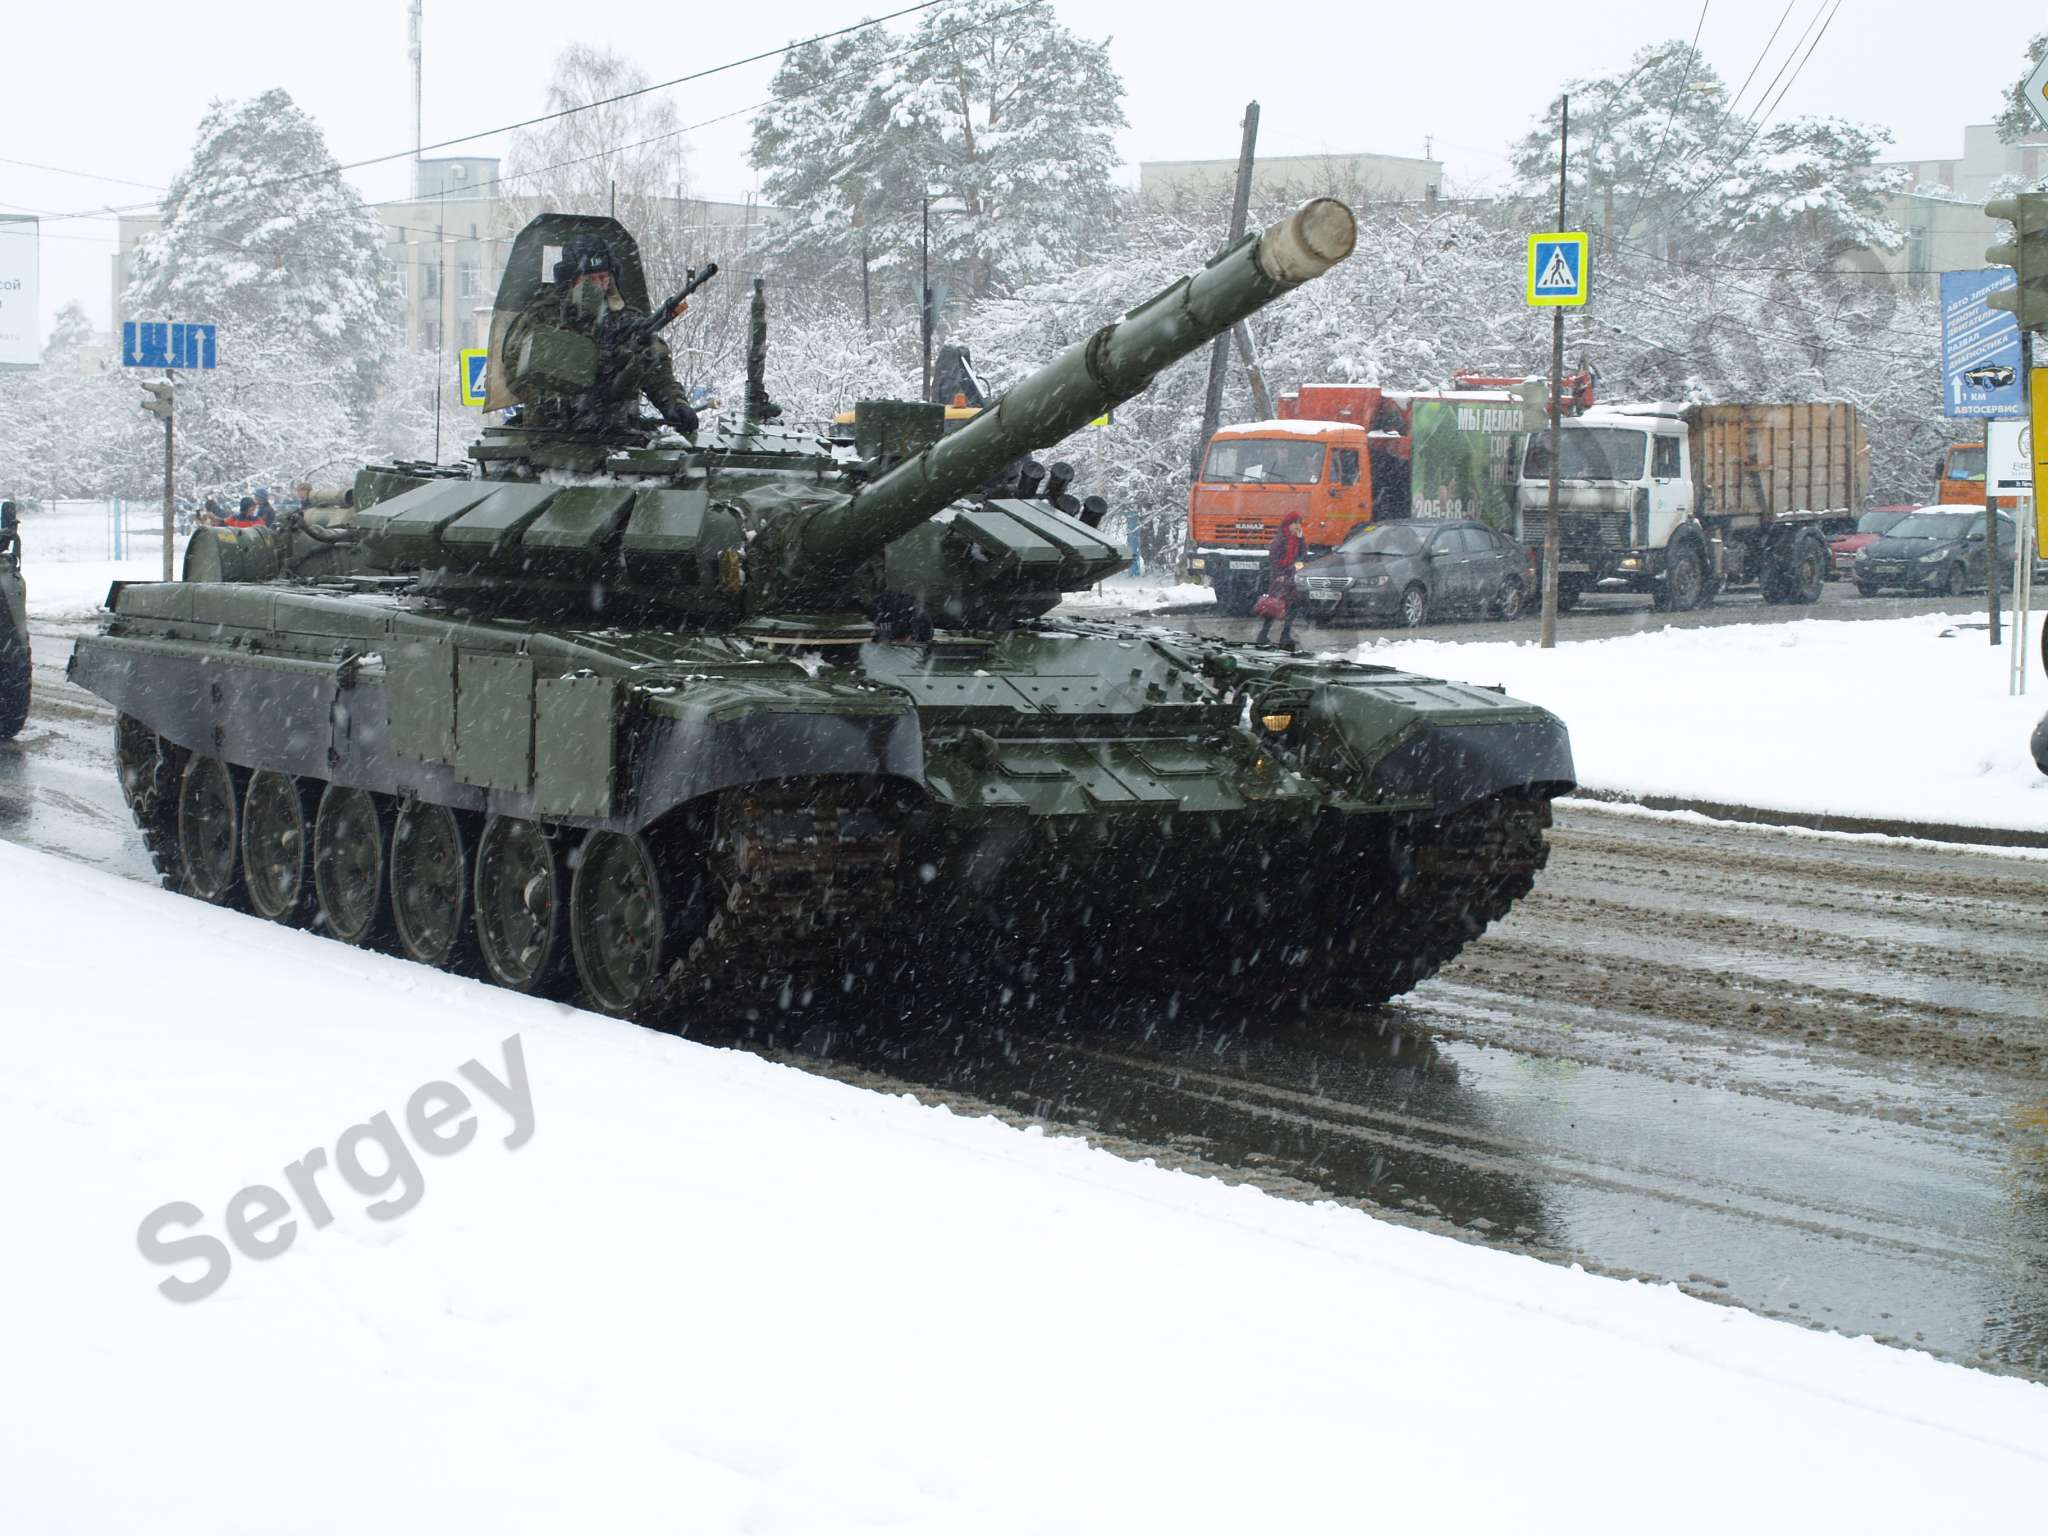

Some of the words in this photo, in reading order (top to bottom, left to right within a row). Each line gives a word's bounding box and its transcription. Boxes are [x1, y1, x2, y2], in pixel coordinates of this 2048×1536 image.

[1947, 297, 1969, 312] АВТО
[1971, 274, 2012, 302] ЭЛЕКТРИК
[1947, 307, 1979, 328] РЕМОНТ
[1948, 332, 1980, 354] РАЗВАЛ
[1948, 335, 2009, 370] ДИАГНОСТИКА
[1962, 392, 1967, 401] 1
[1971, 392, 1986, 401] КМ
[1457, 407, 1480, 431] МЫ
[1954, 404, 2018, 414] АВТОСЕРВИС
